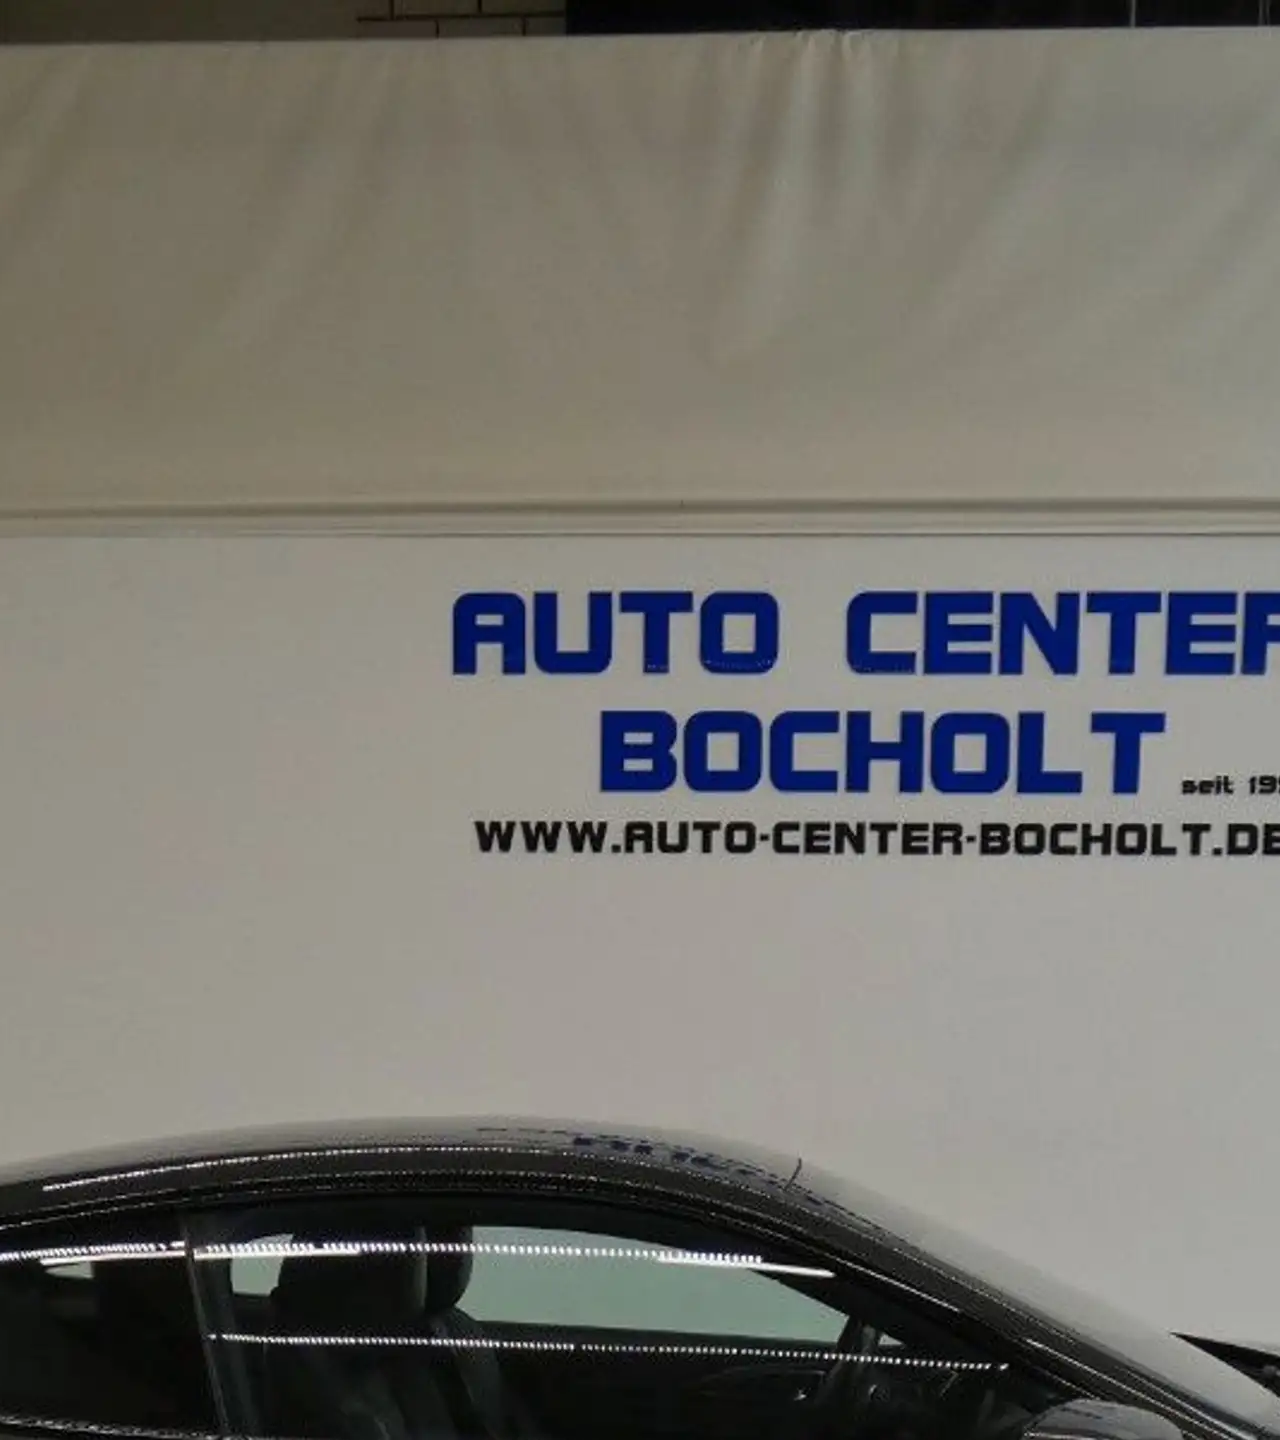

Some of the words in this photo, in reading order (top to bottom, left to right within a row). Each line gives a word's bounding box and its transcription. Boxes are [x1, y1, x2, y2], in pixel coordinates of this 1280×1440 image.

[452, 590, 780, 676] AUTO
[599, 710, 1167, 795] BOCHOLT
[1181, 775, 1235, 796] seit
